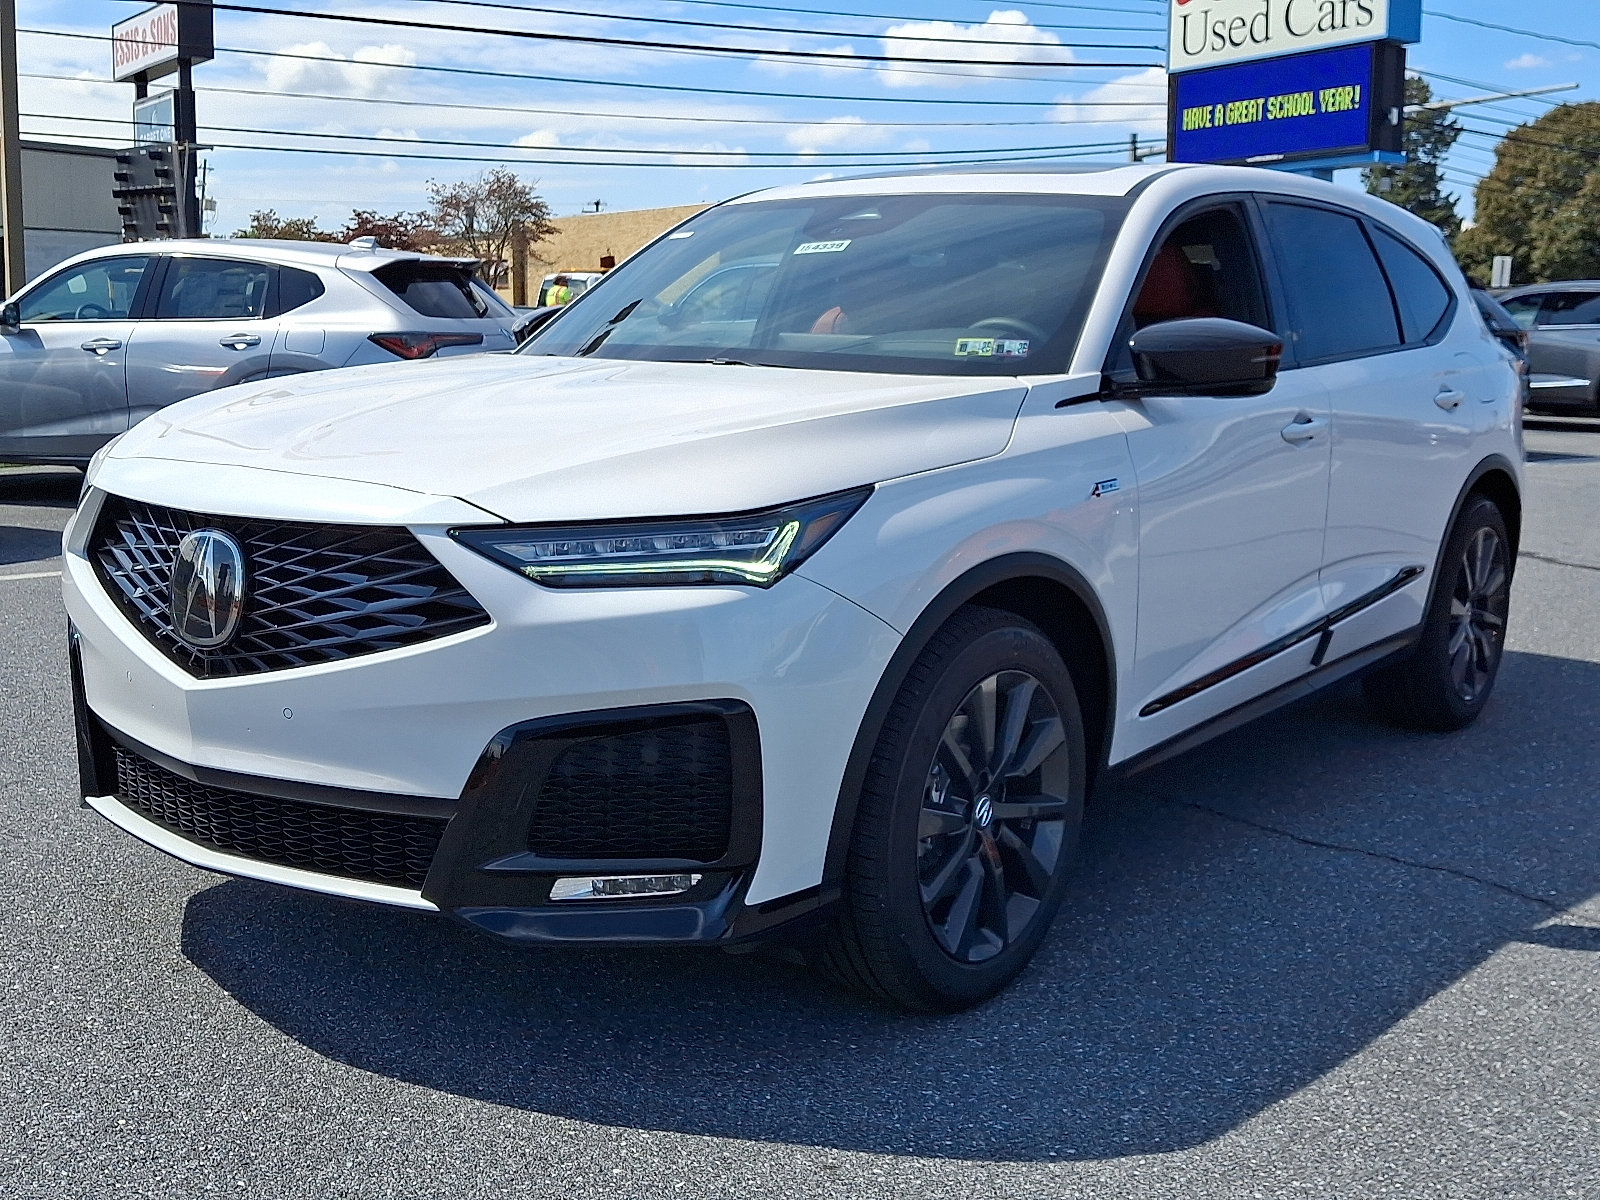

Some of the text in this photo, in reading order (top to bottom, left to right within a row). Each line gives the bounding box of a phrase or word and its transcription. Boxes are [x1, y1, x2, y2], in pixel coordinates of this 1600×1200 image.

[141, 28, 149, 57] &
[150, 9, 177, 53] SONS
[1180, 0, 1374, 56] Used Cars
[1182, 85, 1361, 131] HAVE A GREAT SCHOOL YEAR!
